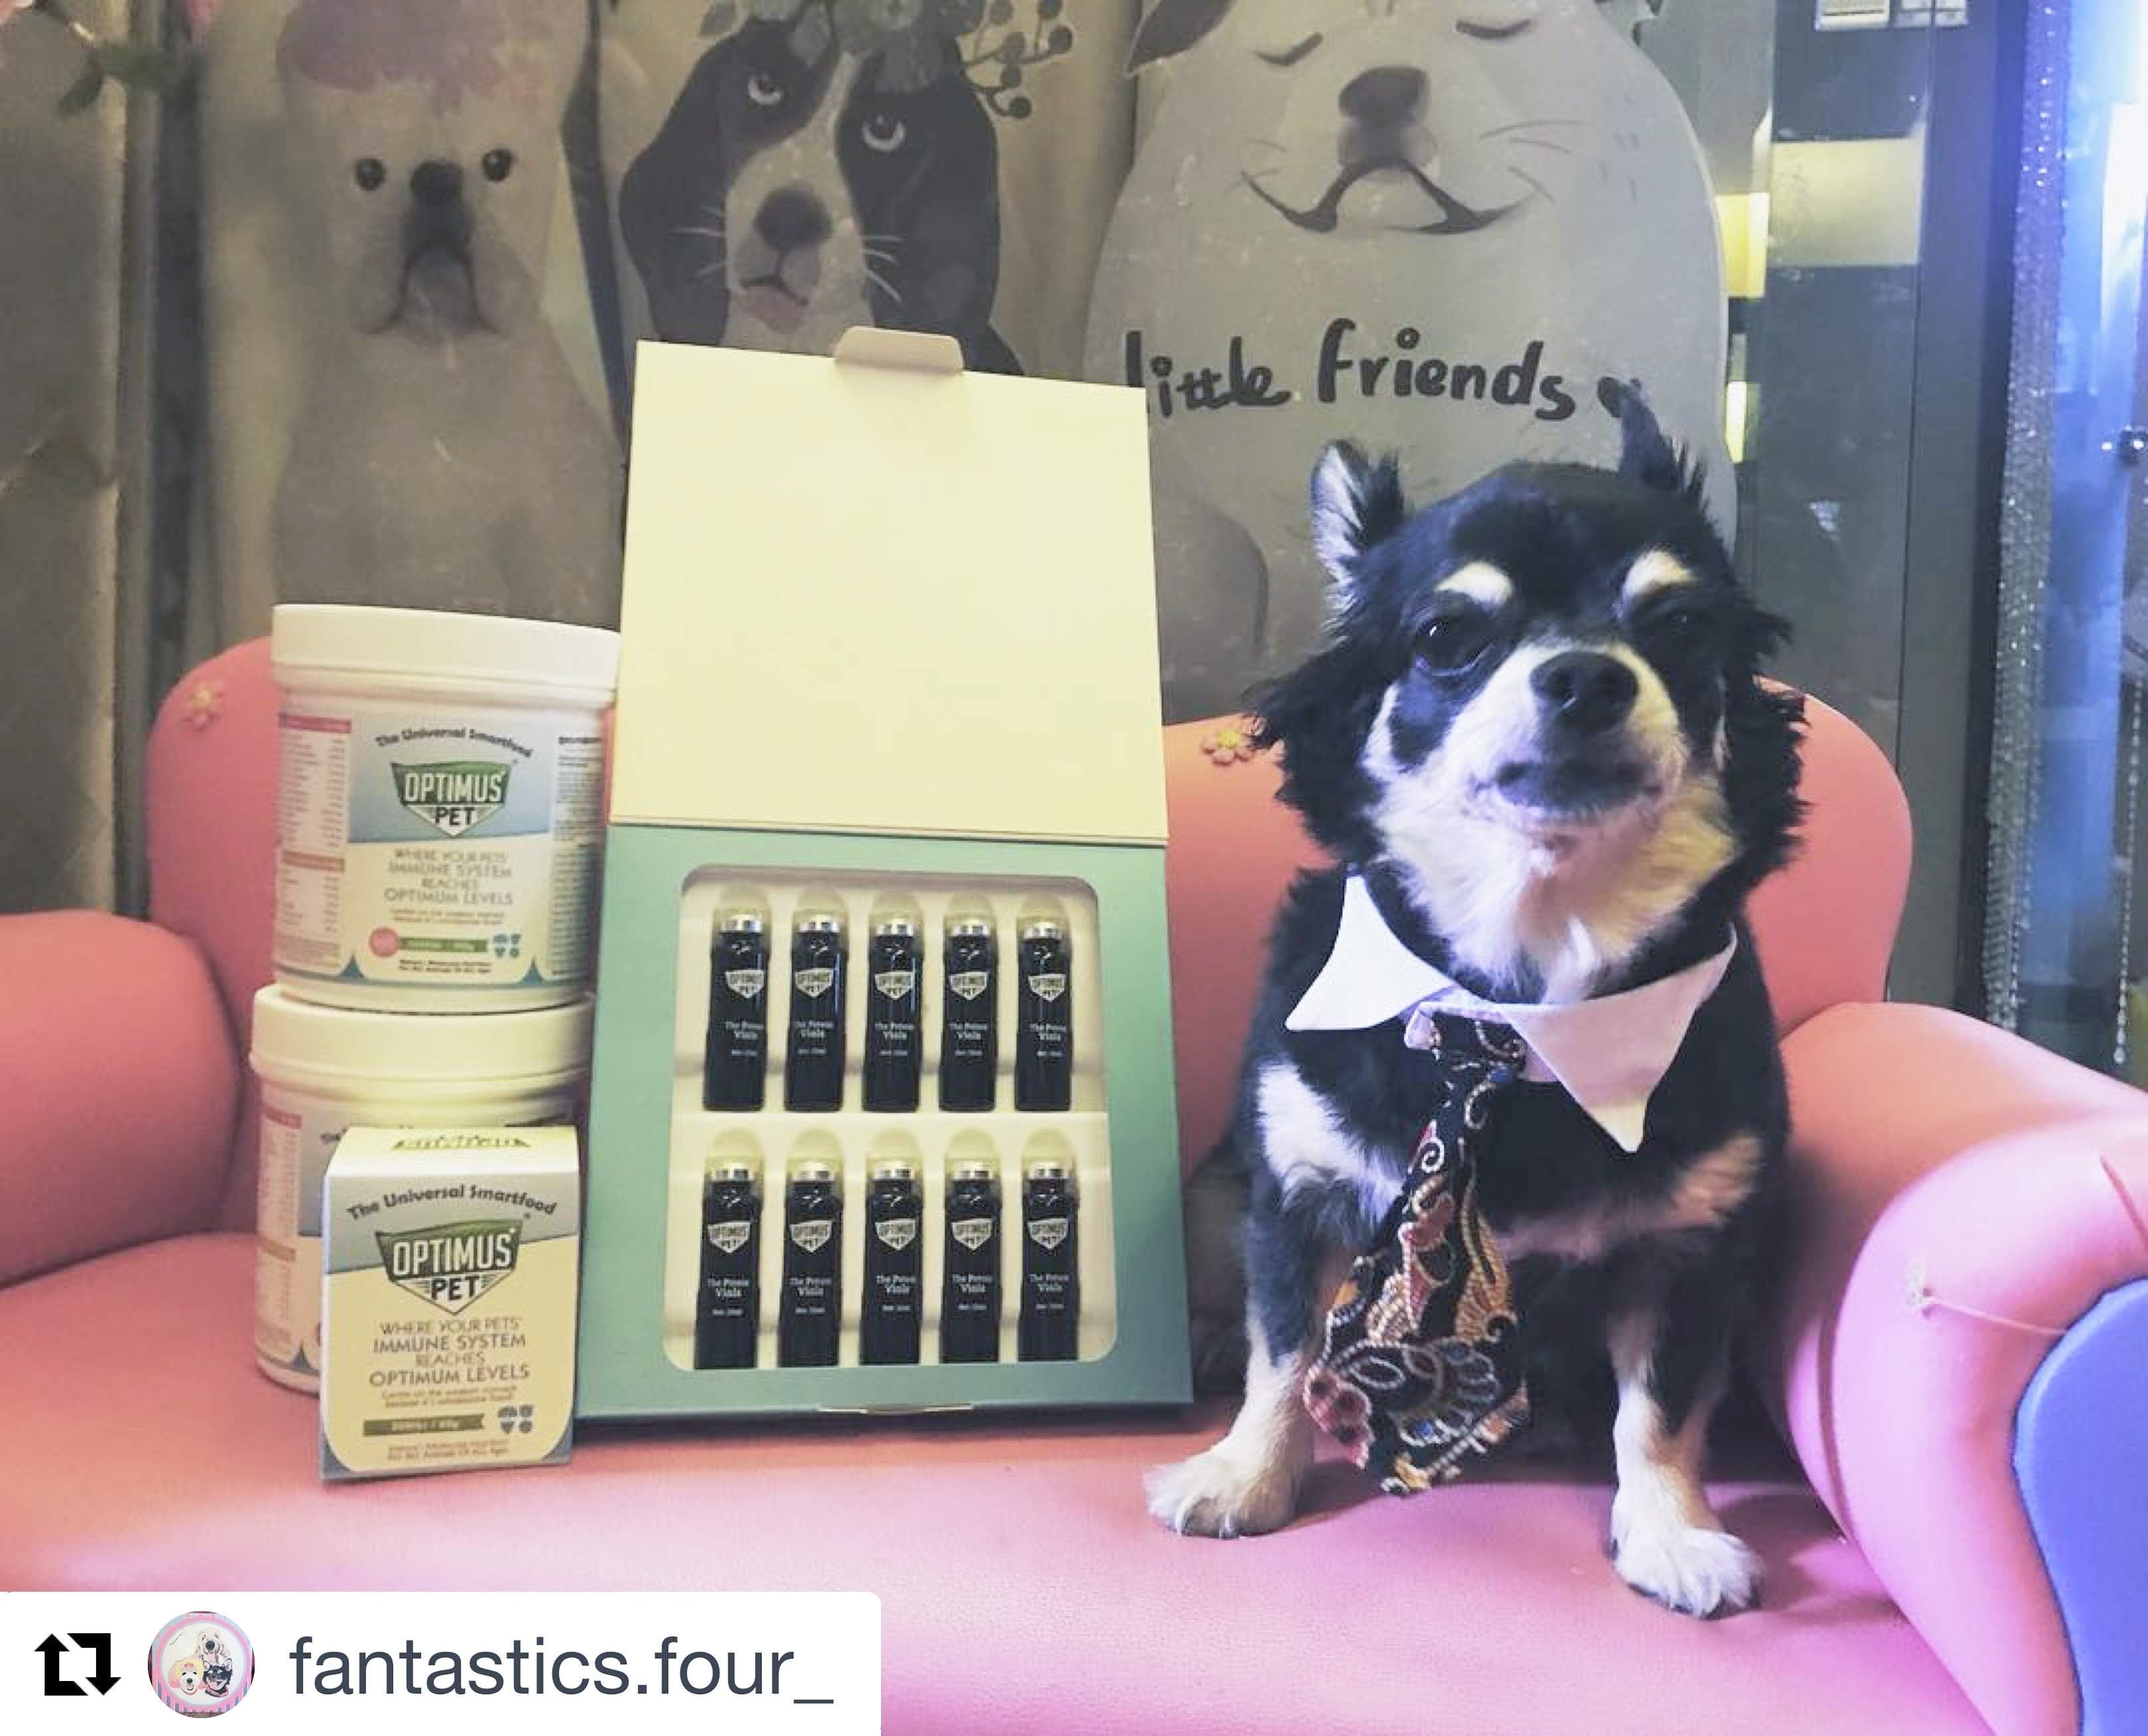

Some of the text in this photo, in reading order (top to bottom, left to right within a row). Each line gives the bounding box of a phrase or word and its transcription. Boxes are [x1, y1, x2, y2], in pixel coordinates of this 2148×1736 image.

[405, 772, 503, 802] OPTIMUS
[435, 807, 475, 826] PET
[457, 864, 511, 878] SYSTEM
[384, 888, 513, 905] OPTIMUM LEVELS
[347, 1185, 558, 1219] The Universal Smartfood
[393, 1234, 512, 1277] OPTIMUS
[431, 1275, 480, 1301] PET
[381, 1320, 432, 1334] WHERE
[439, 1318, 481, 1333] YOUR
[373, 1334, 526, 1354] IMMUNE SYSTEM
[416, 1352, 485, 1367] REACHES
[369, 1363, 530, 1387] OPTIMUM LEVELS
